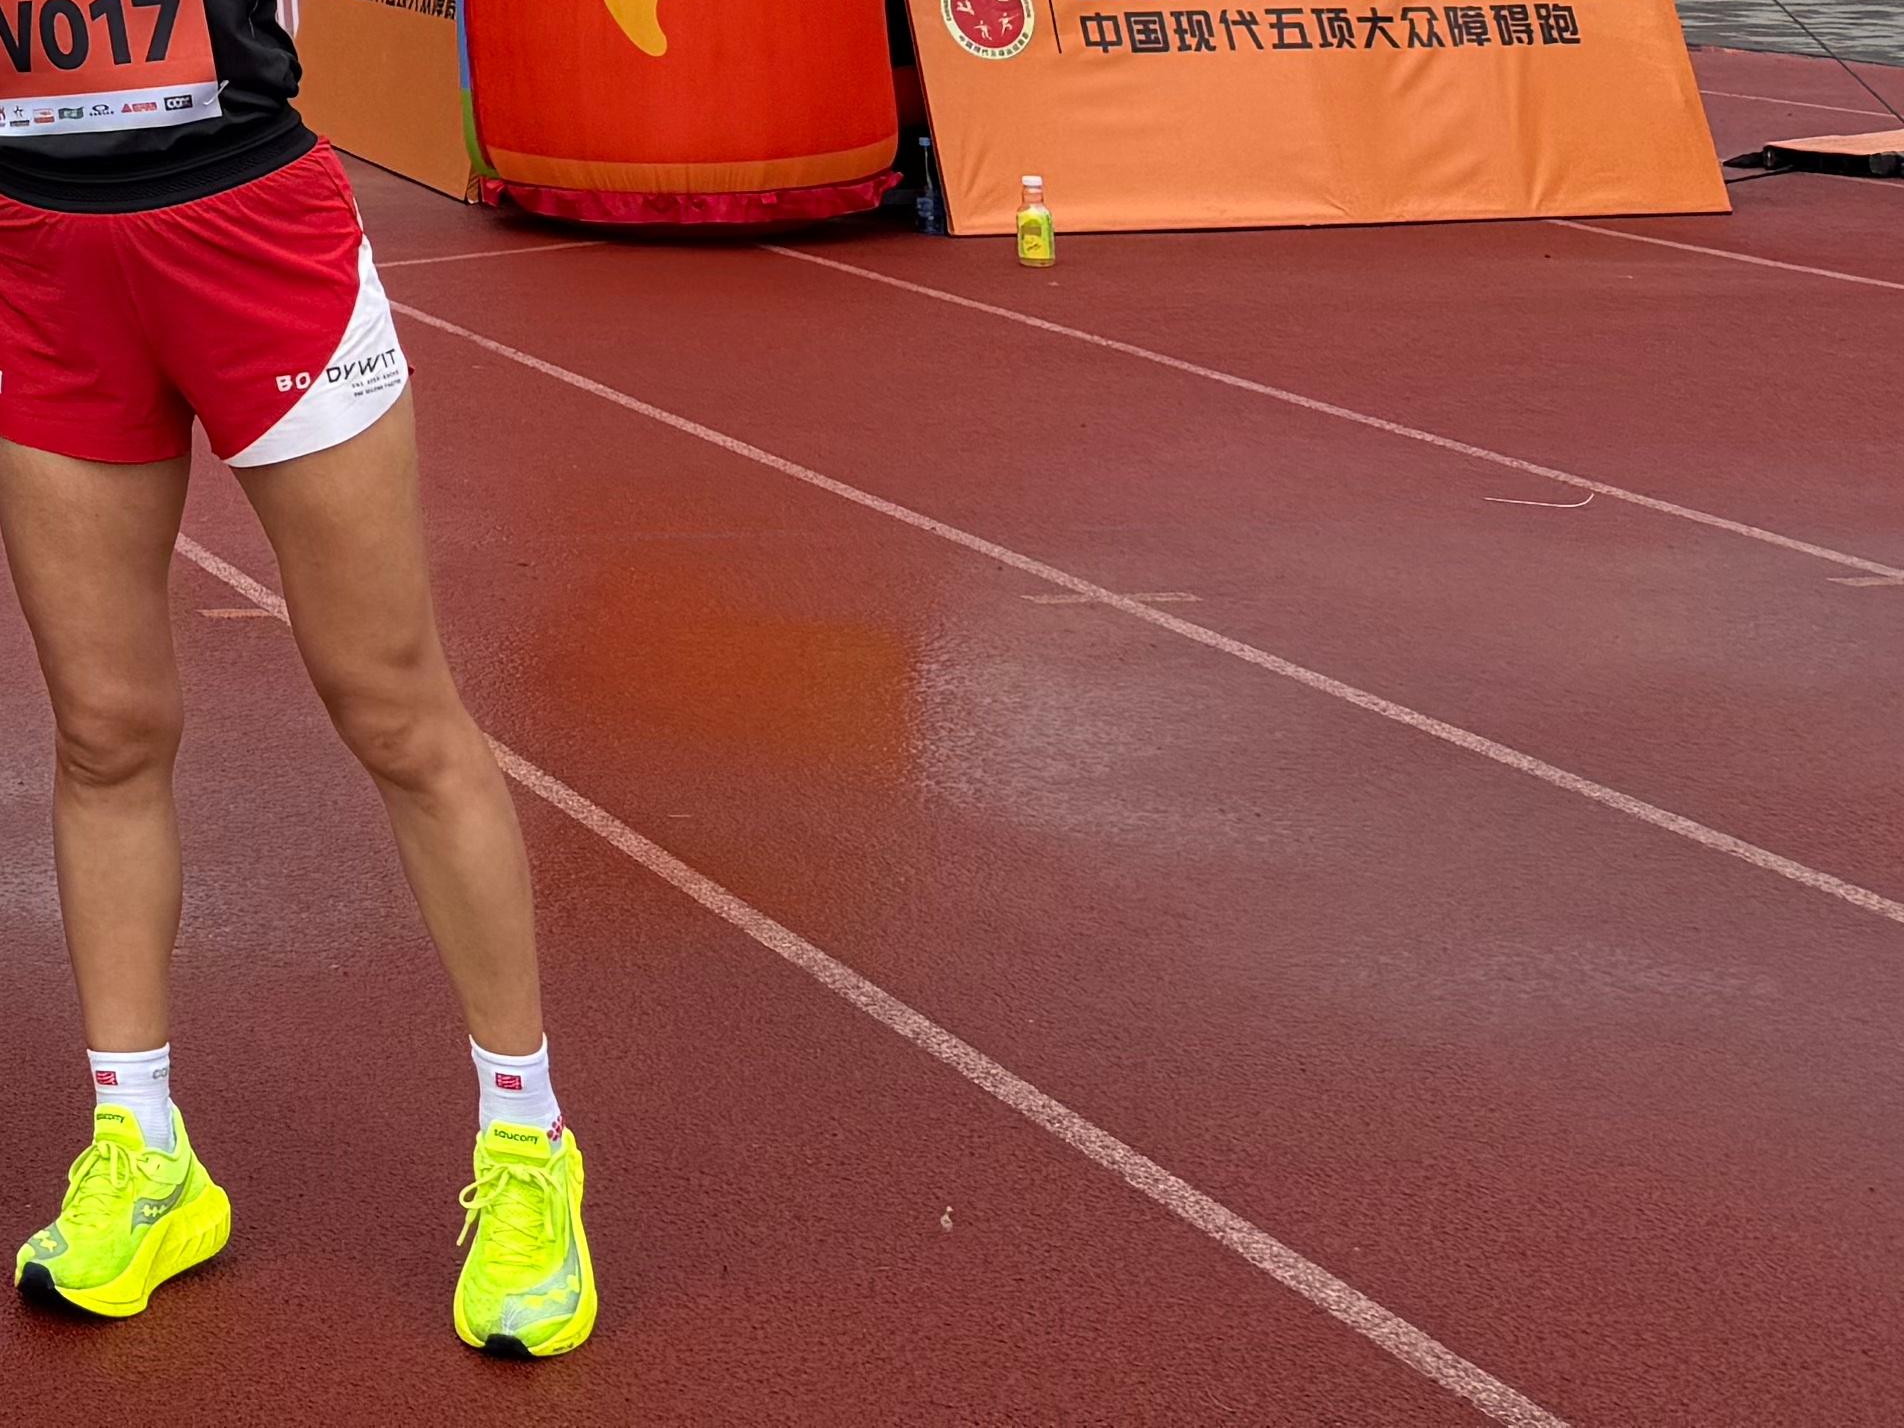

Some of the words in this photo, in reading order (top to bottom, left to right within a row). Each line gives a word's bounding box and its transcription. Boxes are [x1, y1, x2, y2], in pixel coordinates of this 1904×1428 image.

[1080, 3, 1581, 53] 中国现代五项大众障碍跑
